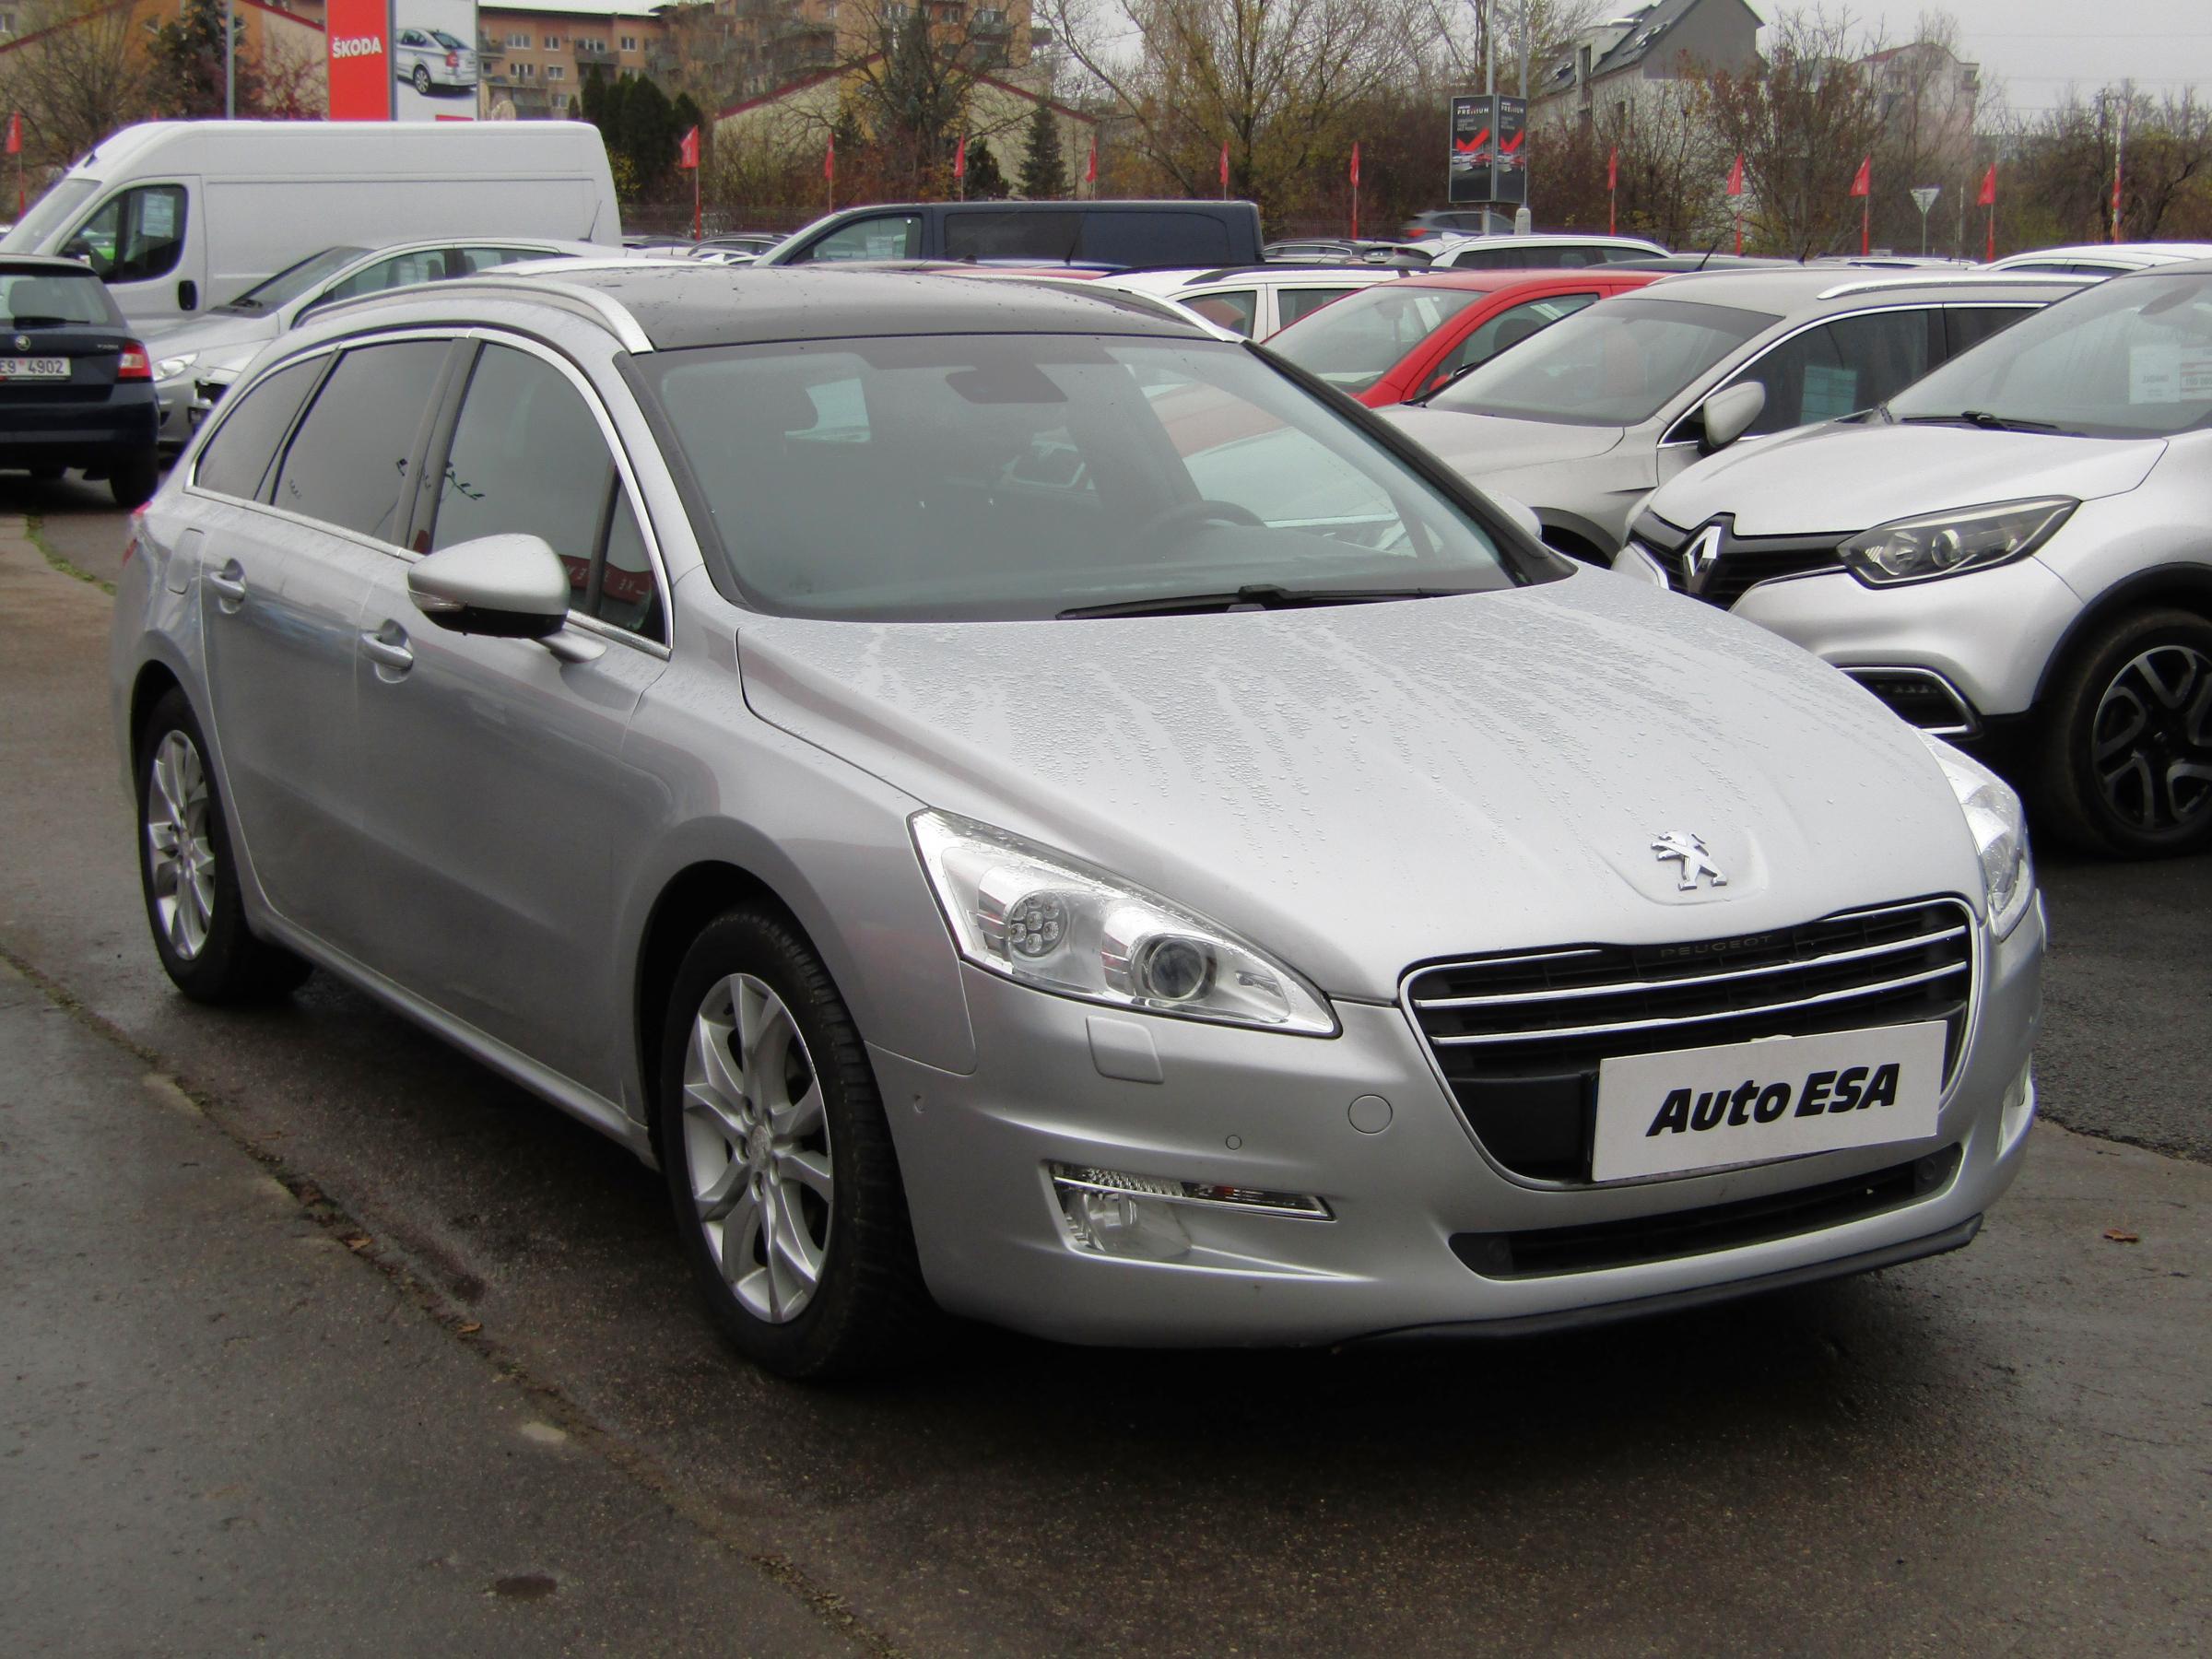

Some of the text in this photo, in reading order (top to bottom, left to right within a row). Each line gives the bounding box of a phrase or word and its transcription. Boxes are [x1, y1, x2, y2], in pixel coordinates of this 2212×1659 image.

[332, 37, 382, 59] ŠKODA
[29, 359, 65, 374] 4902
[1661, 935, 1773, 959] PEUGEOT
[1645, 1063, 1900, 1137] Auto ESA
